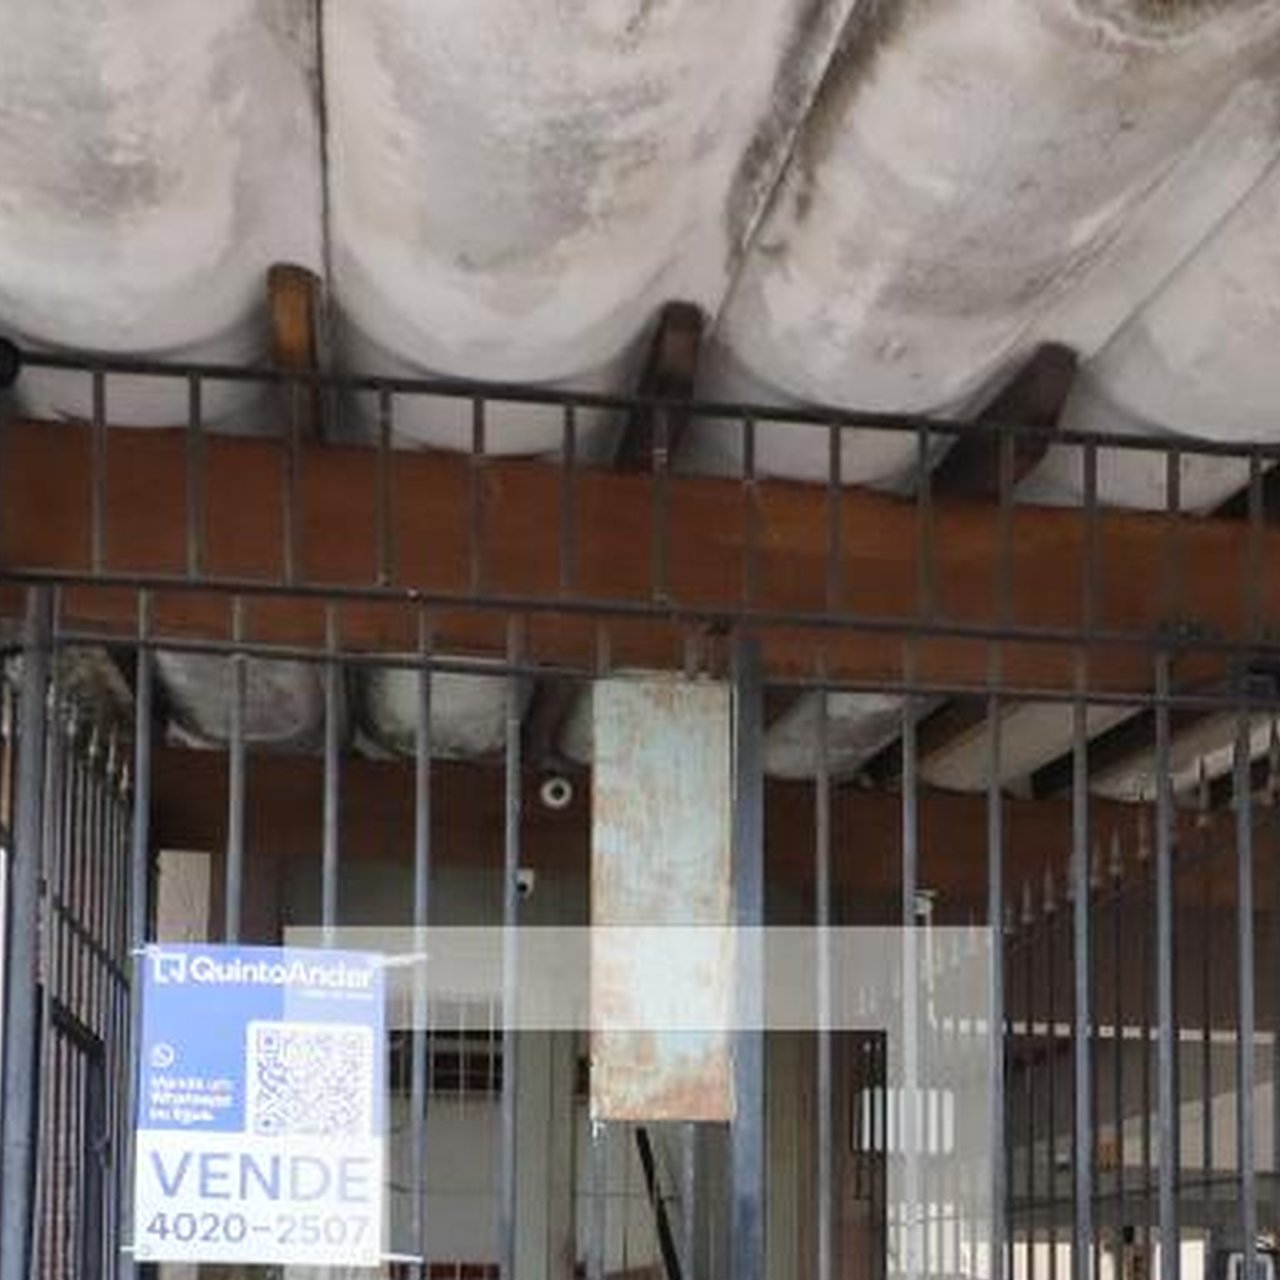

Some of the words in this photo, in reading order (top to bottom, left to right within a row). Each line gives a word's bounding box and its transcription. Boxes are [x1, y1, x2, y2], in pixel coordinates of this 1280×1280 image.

[191, 956, 373, 988] QuintoAndar
[150, 1150, 372, 1204] VENDE
[146, 1212, 371, 1248] 4020-2507
